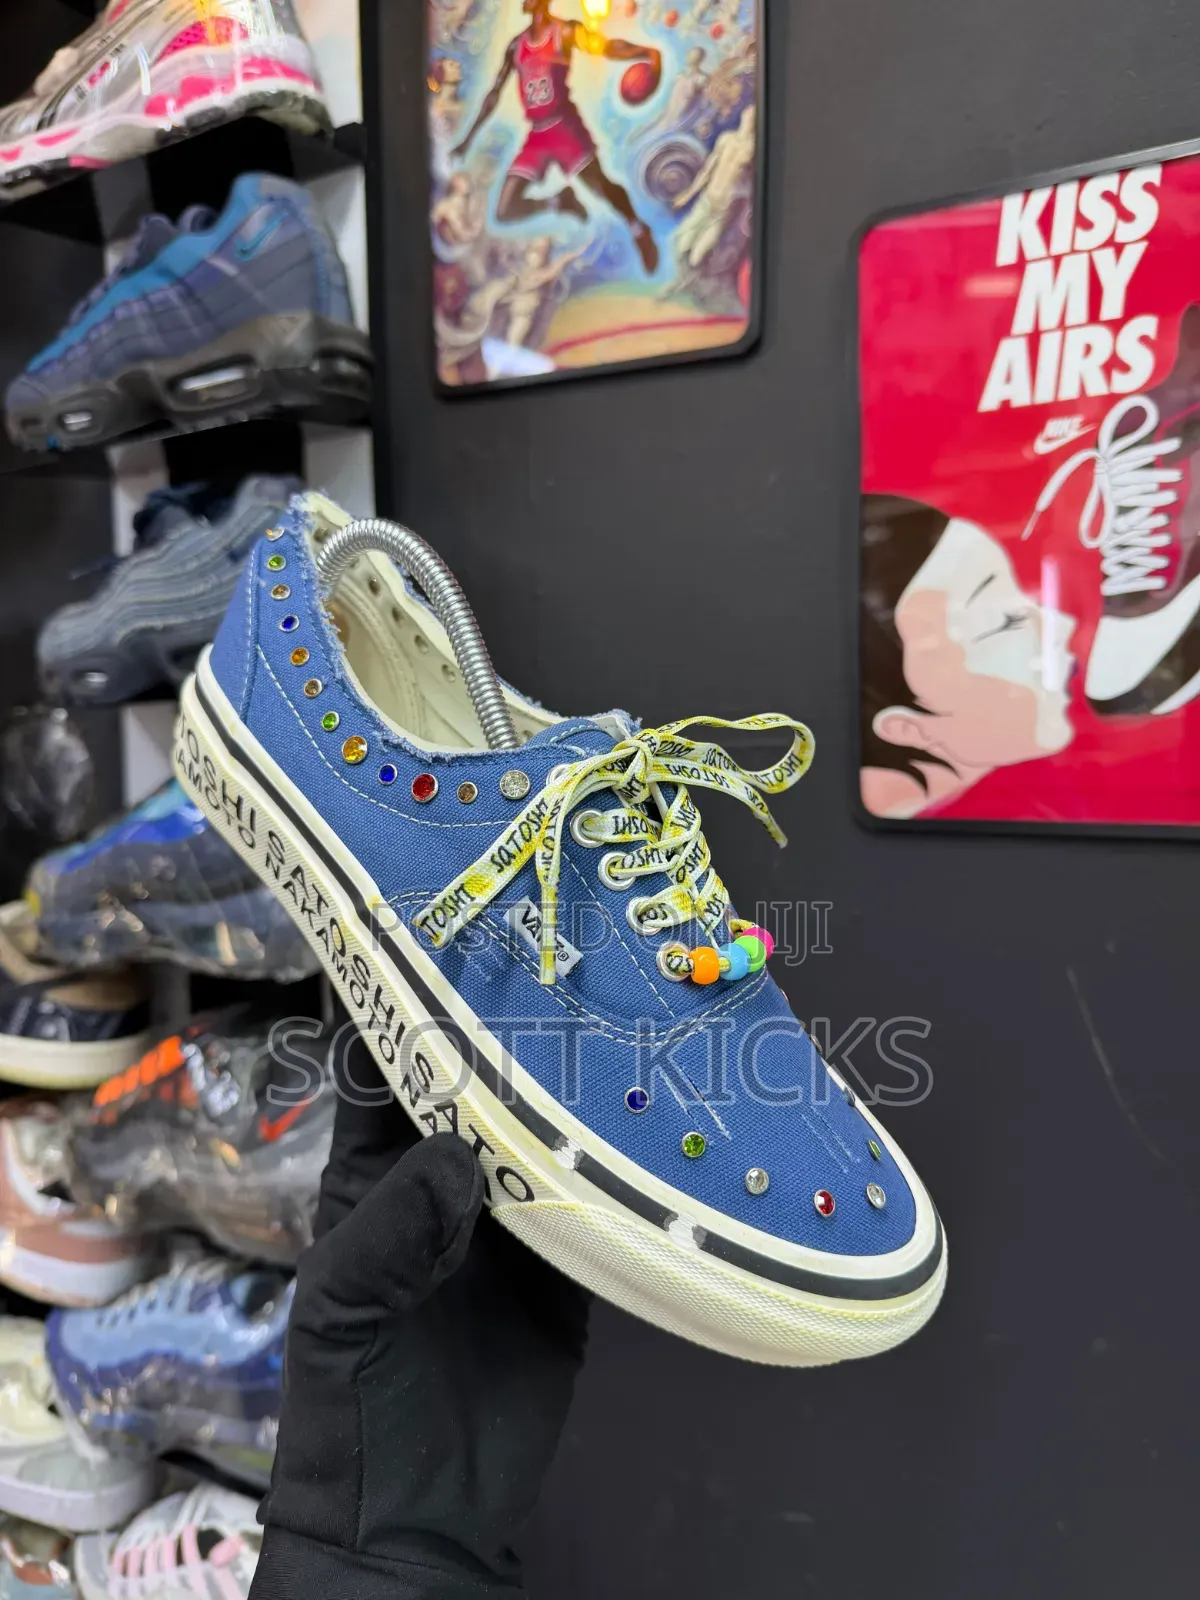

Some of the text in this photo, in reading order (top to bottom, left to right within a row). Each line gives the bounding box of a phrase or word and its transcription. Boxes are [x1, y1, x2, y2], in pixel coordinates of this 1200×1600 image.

[996, 164, 1162, 267] KISS
[1011, 241, 1148, 336] MY
[977, 314, 1158, 412] AIRS
[265, 852, 396, 1065] NAKAMOTO
[269, 830, 406, 1048] SATOSHI
